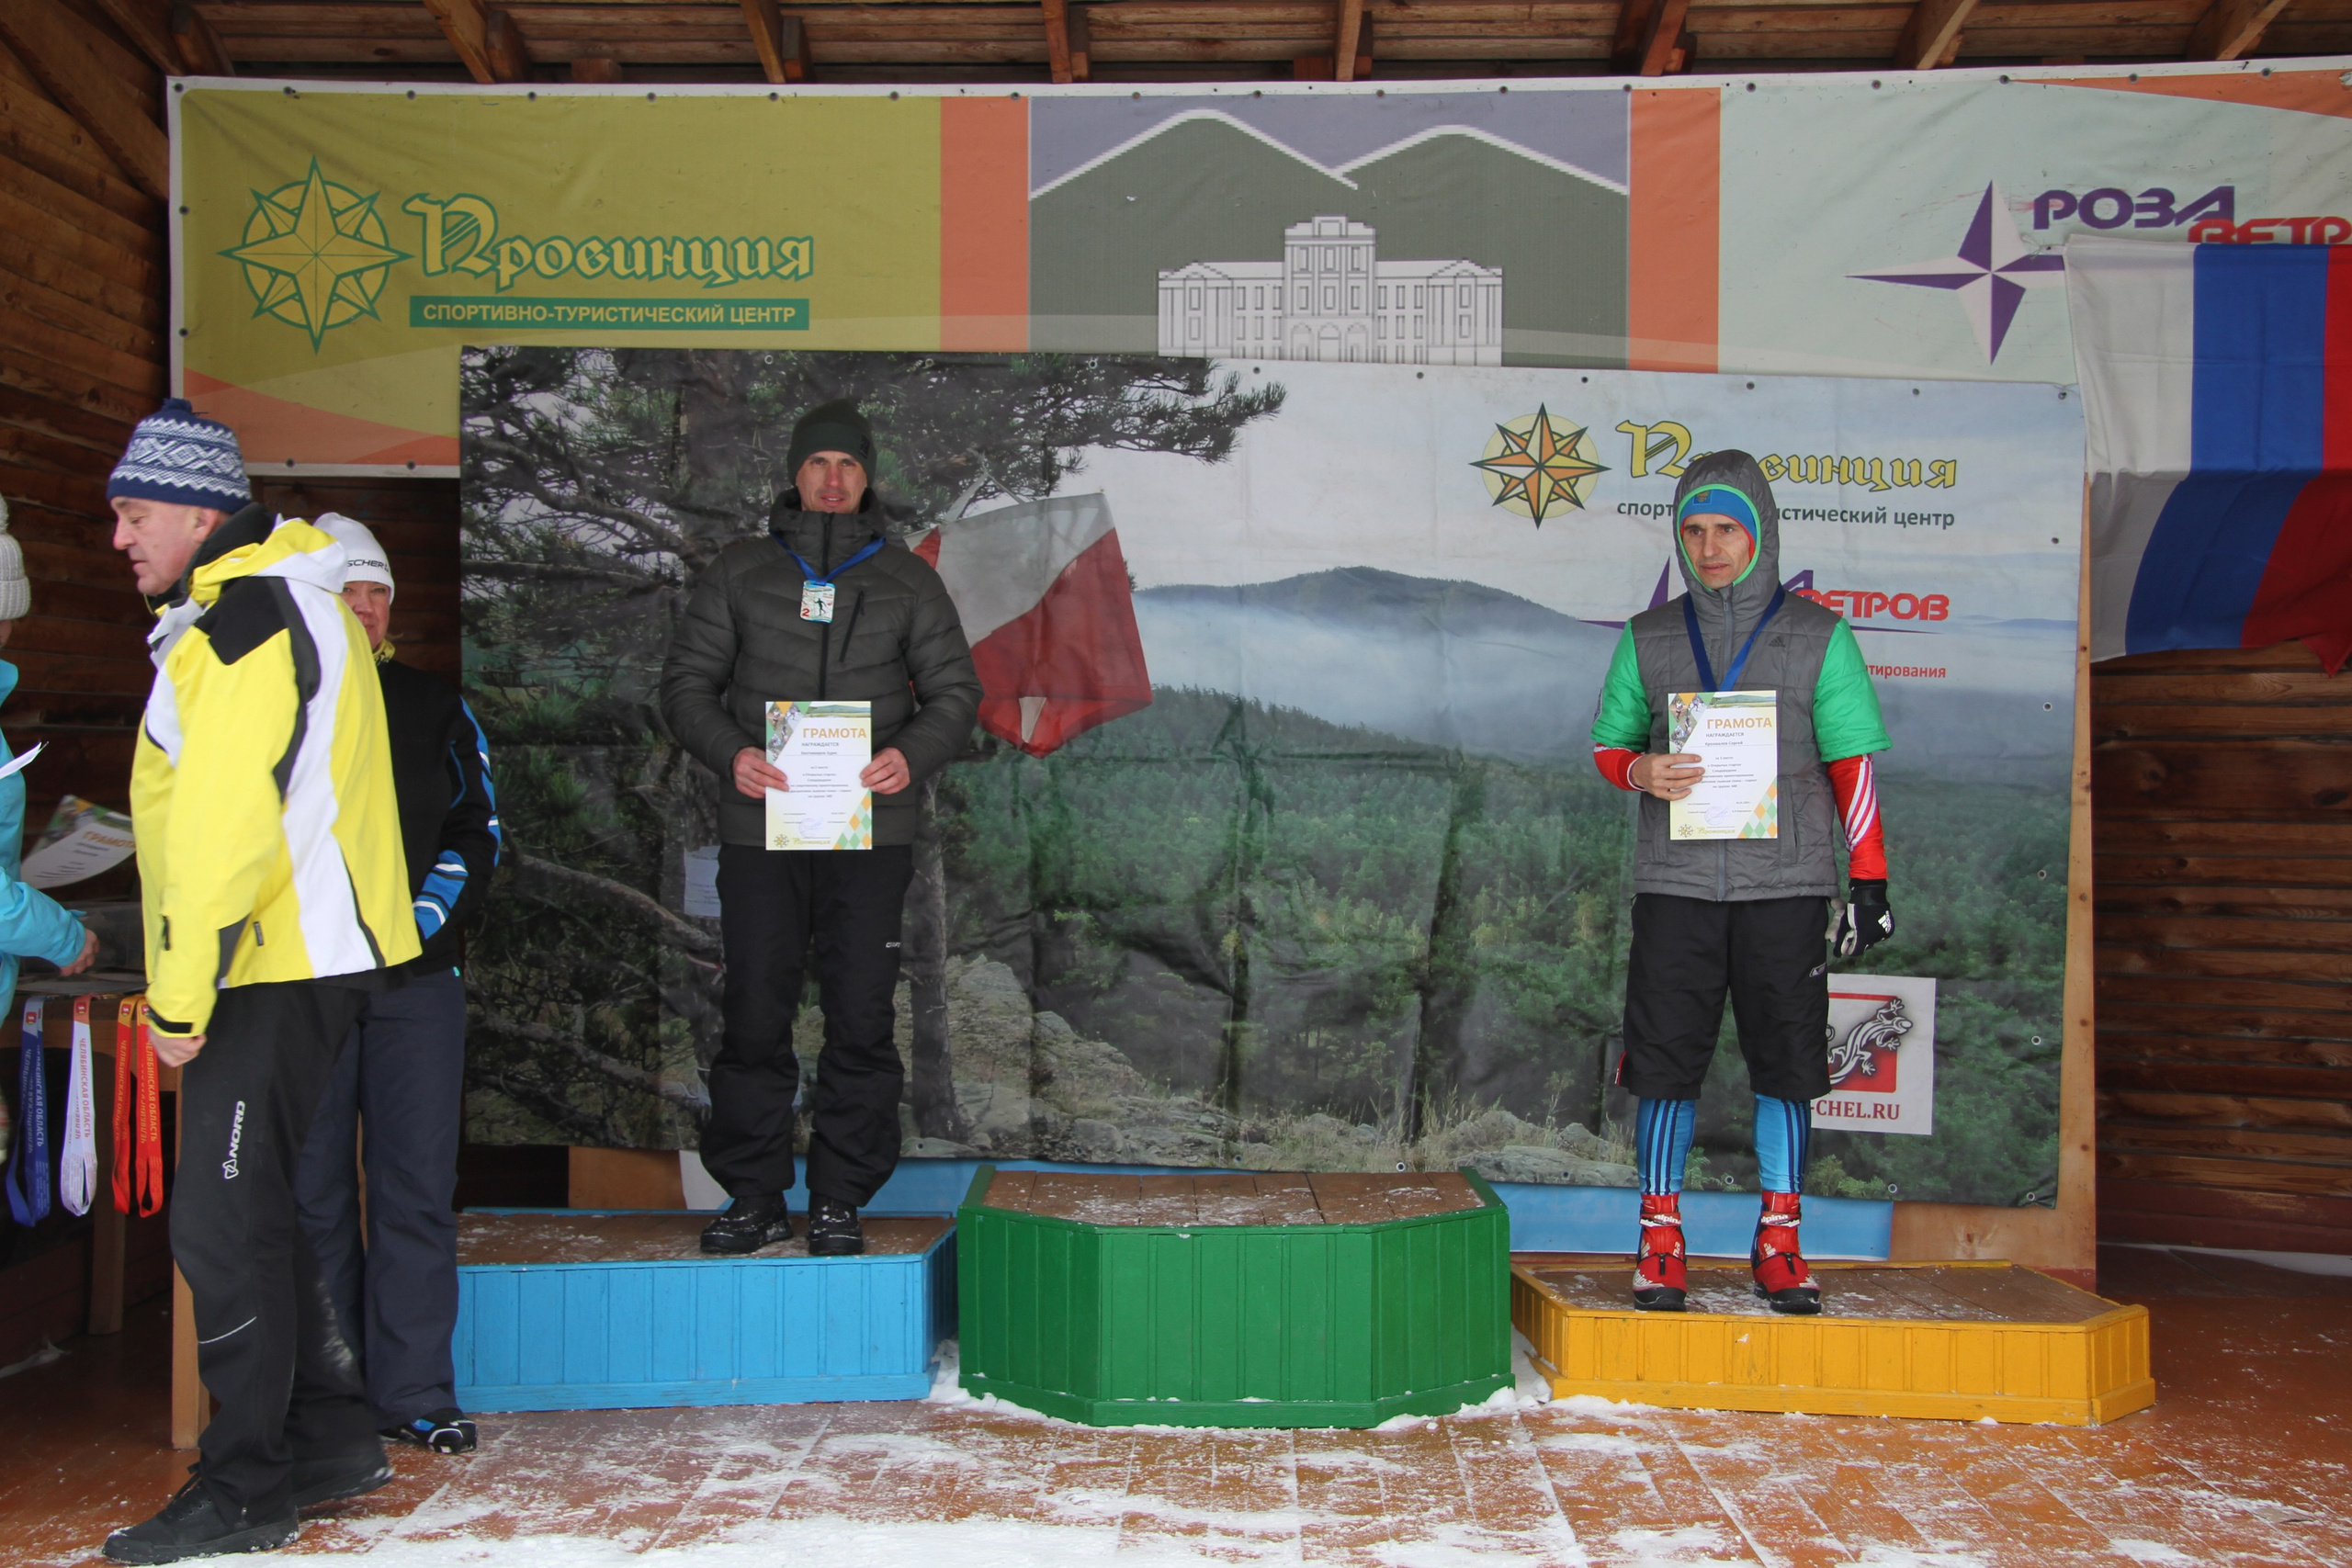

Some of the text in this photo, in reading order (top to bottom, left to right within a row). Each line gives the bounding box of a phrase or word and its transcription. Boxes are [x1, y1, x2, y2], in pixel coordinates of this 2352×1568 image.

[2032, 186, 2235, 231] РОЗА
[401, 193, 814, 293] Провинция
[2188, 215, 2352, 243] ВЕТР
[423, 303, 797, 325] СПОРТИВНО-ТУРИСТИЧЕСКИЙ ЦЕНТР
[1615, 420, 1957, 491] Пвинция
[1894, 510, 1955, 530] центр
[346, 559, 384, 569] SCHER
[801, 608, 810, 617] 2
[1865, 664, 1947, 679] тирования
[802, 728, 866, 739] ГРАМОТА
[1707, 717, 1772, 729] ГРАМОТА
[118, 1040, 127, 1101] ЧЕЛЯБИНСКАЯ
[79, 1038, 91, 1138] ЧЕЛЯБИНСКАЯ ОБЛАСТЬ
[149, 1103, 158, 1142] ОБЛАСТЬ
[1810, 1099, 1900, 1120] -CHEL.RU
[36, 1108, 44, 1147] ОБЛАСТЬ
[229, 1100, 246, 1158] NORD
